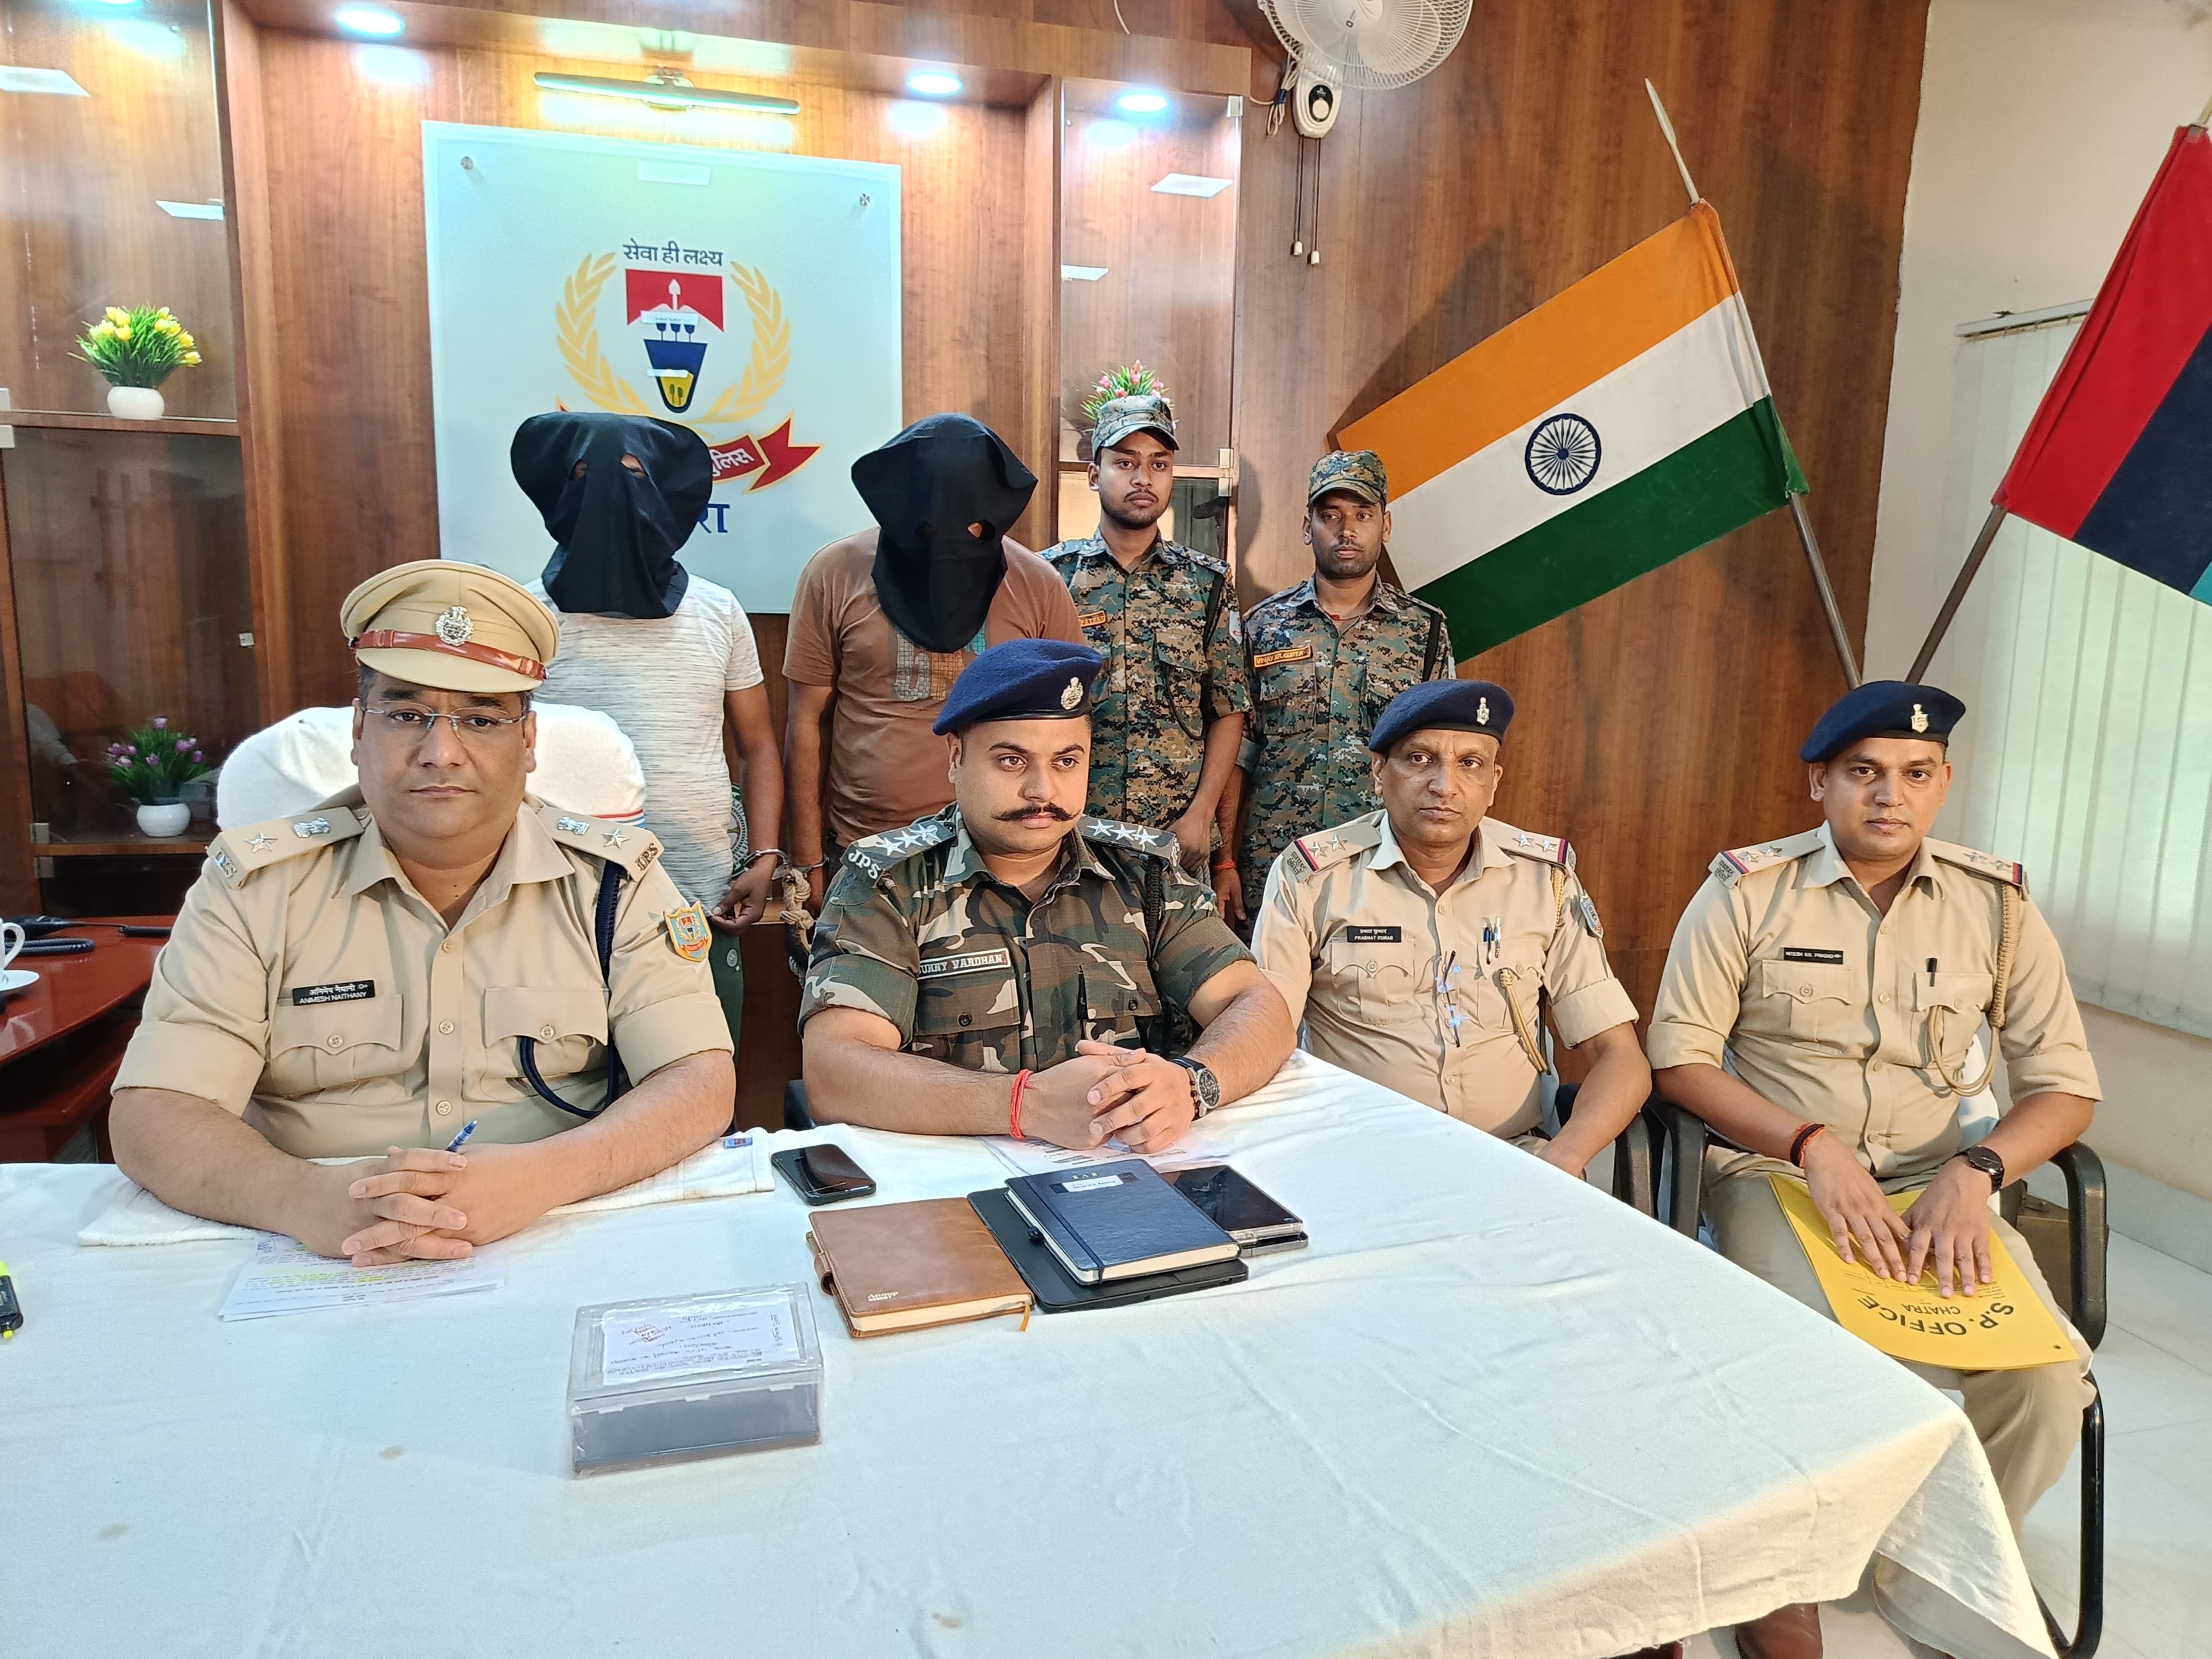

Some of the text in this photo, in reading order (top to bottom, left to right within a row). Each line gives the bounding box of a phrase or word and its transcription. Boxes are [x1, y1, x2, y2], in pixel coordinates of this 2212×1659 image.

[623, 237, 723, 266] सेवा ही लक्ष्य
[848, 849, 881, 879] JPS
[952, 953, 1003, 969] VARDHAN
[299, 992, 367, 1004] ANIMESH NAITHANY
[1856, 1295, 1967, 1336] OFFICE
[1901, 1302, 1961, 1315] CHATRA
